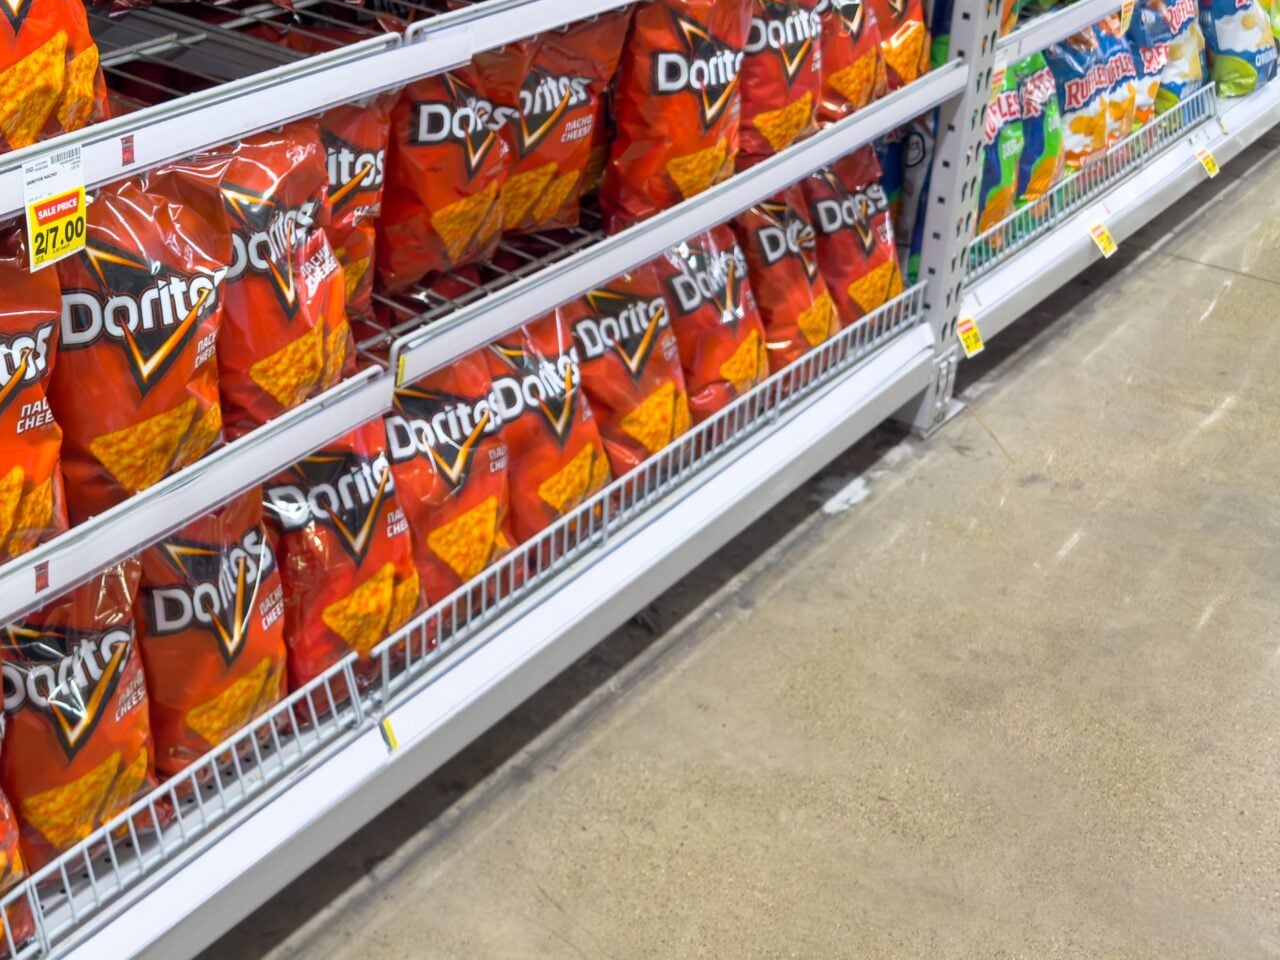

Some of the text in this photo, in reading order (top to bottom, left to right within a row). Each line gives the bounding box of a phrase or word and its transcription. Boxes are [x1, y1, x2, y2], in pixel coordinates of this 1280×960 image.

[37, 197, 78, 220] SALE PRICE
[34, 216, 85, 256] 2/7.00
[61, 267, 229, 345] Dorito
[575, 296, 669, 359] Dorito
[16, 413, 54, 435] CHEE
[20, 398, 50, 415] NAC
[268, 450, 393, 529] Dorito
[3, 628, 133, 711] Dorito
